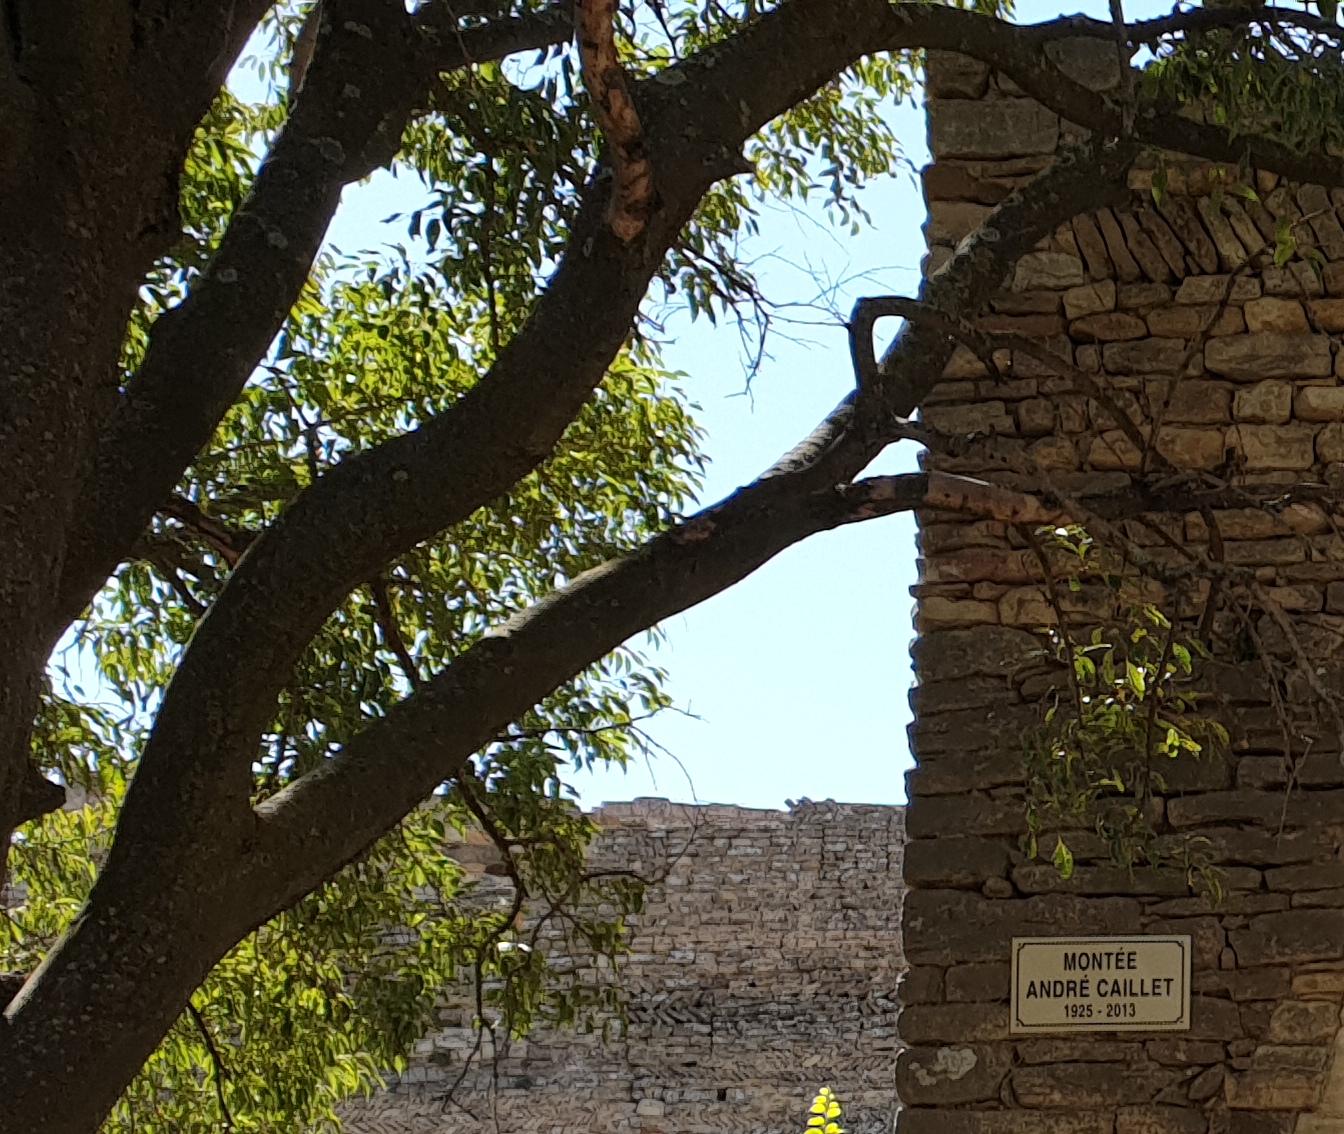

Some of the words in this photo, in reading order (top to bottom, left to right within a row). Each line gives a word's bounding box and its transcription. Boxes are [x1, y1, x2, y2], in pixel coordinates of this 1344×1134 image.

[1063, 947, 1138, 971] MONTÉE
[1026, 975, 1090, 999] ANDRÉ
[1097, 978, 1174, 998] CAILLET
[1064, 1003, 1093, 1018] 1925
[1106, 1003, 1136, 1017] 2013
